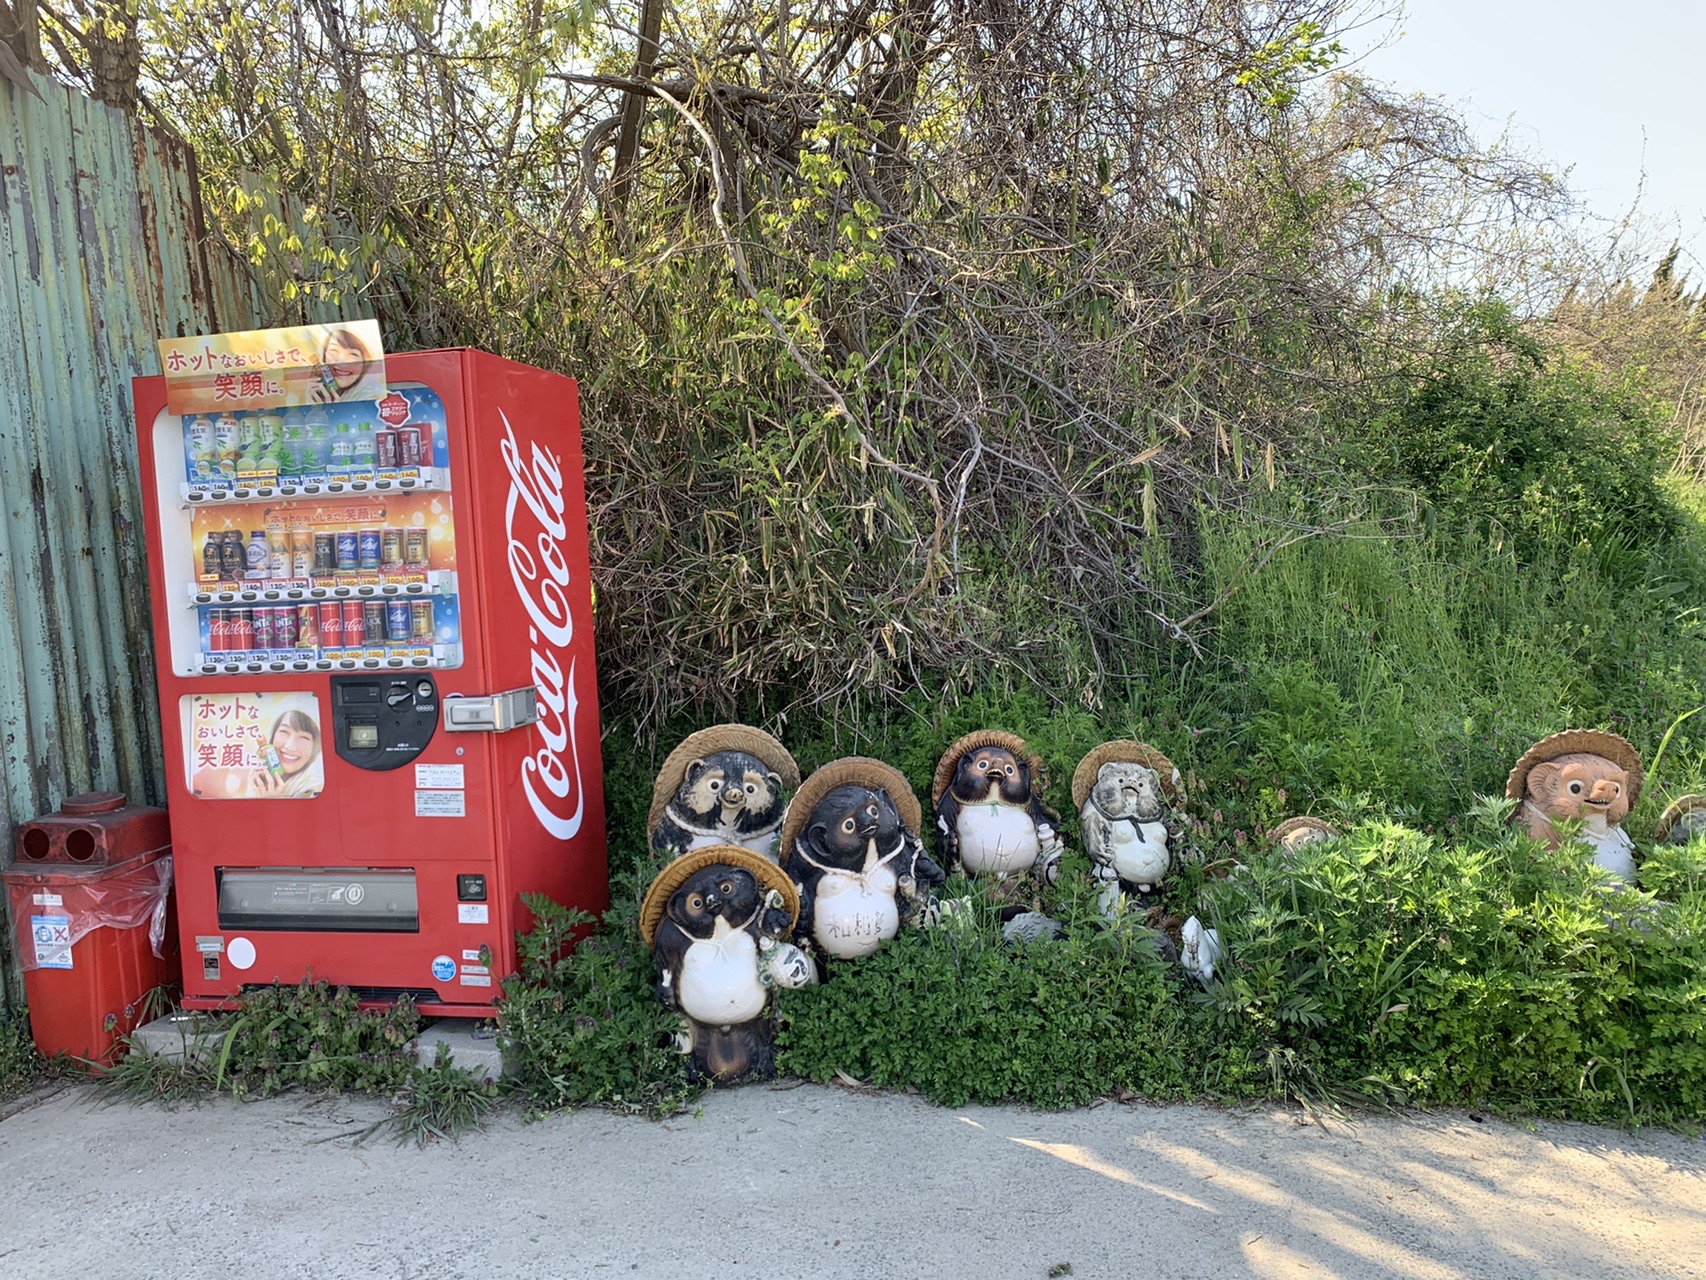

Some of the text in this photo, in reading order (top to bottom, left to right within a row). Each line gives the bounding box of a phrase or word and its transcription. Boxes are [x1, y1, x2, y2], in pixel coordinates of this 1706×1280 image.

[167, 345, 307, 371] ホットなおいしさで、
[213, 371, 285, 400] 笑顔に。
[497, 406, 583, 840] Coca-Cola
[198, 697, 260, 720] ホットな
[197, 725, 262, 739] おいしさで、
[197, 743, 262, 768] 笑顔に。
